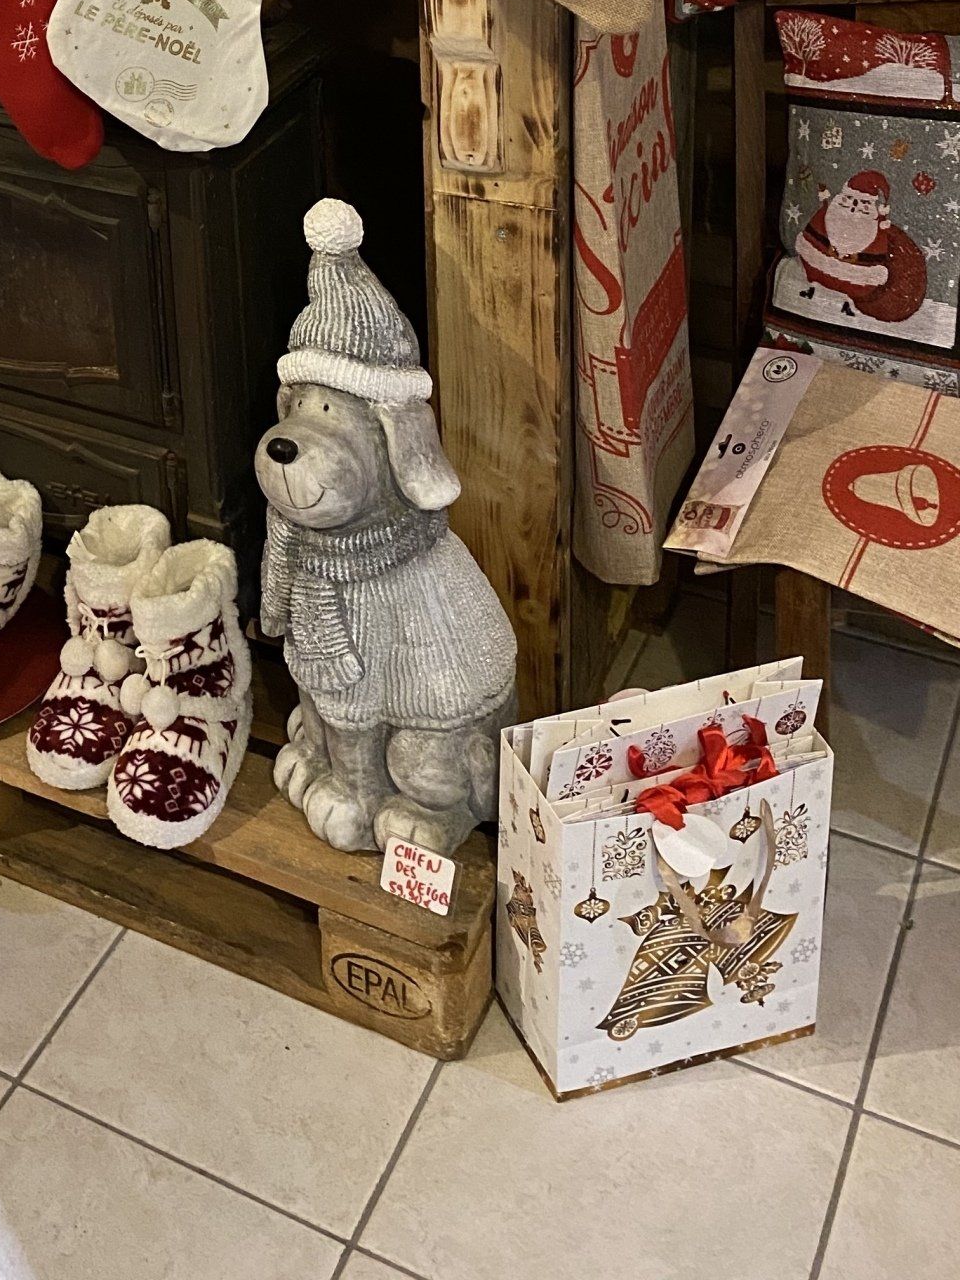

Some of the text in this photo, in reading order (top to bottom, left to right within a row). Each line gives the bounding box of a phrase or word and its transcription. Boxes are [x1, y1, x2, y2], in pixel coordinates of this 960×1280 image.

[74, 0, 202, 65] LE PÈRE-NOËL
[164, 21, 185, 35] par
[735, 418, 771, 480] atmosphera
[394, 844, 442, 873] CHIEN
[395, 860, 416, 879] DES
[347, 959, 420, 1016] EPAL
